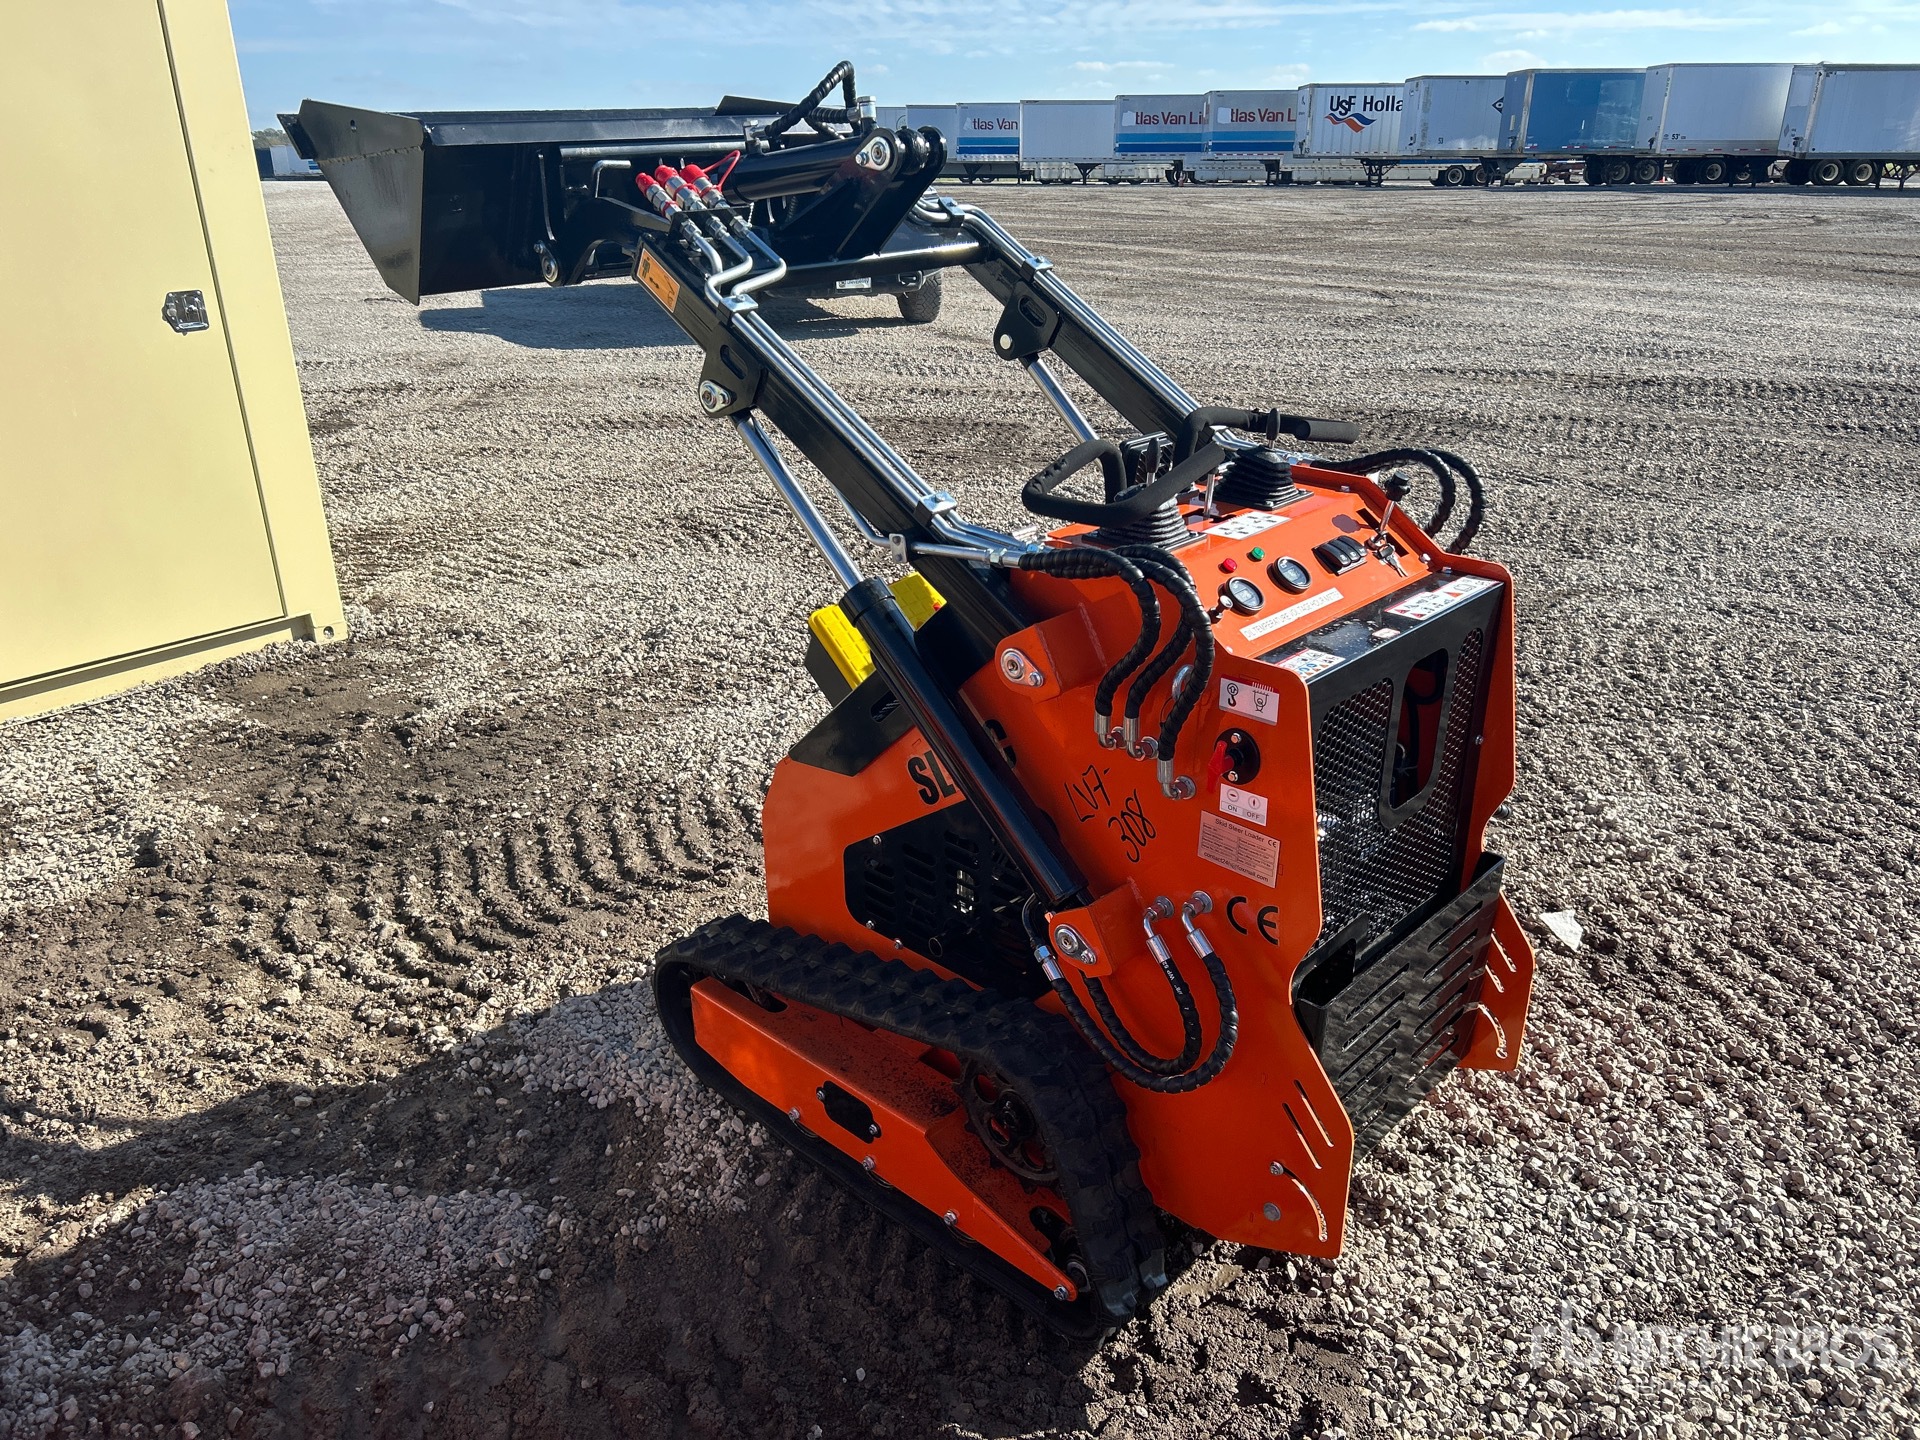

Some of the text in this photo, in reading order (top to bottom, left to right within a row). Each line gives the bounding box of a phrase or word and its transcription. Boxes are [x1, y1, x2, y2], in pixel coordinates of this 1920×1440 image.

[1258, 108, 1284, 122] Van
[1330, 96, 1356, 116] USF
[996, 118, 1018, 130] Van
[1161, 111, 1186, 125] Van
[1227, 804, 1260, 820] ON OFF
[1108, 789, 1156, 863] 308
[1215, 818, 1228, 828] Skid
[1228, 824, 1243, 835] Steer
[1244, 830, 1264, 843] Loader
[1226, 896, 1279, 946] CE
